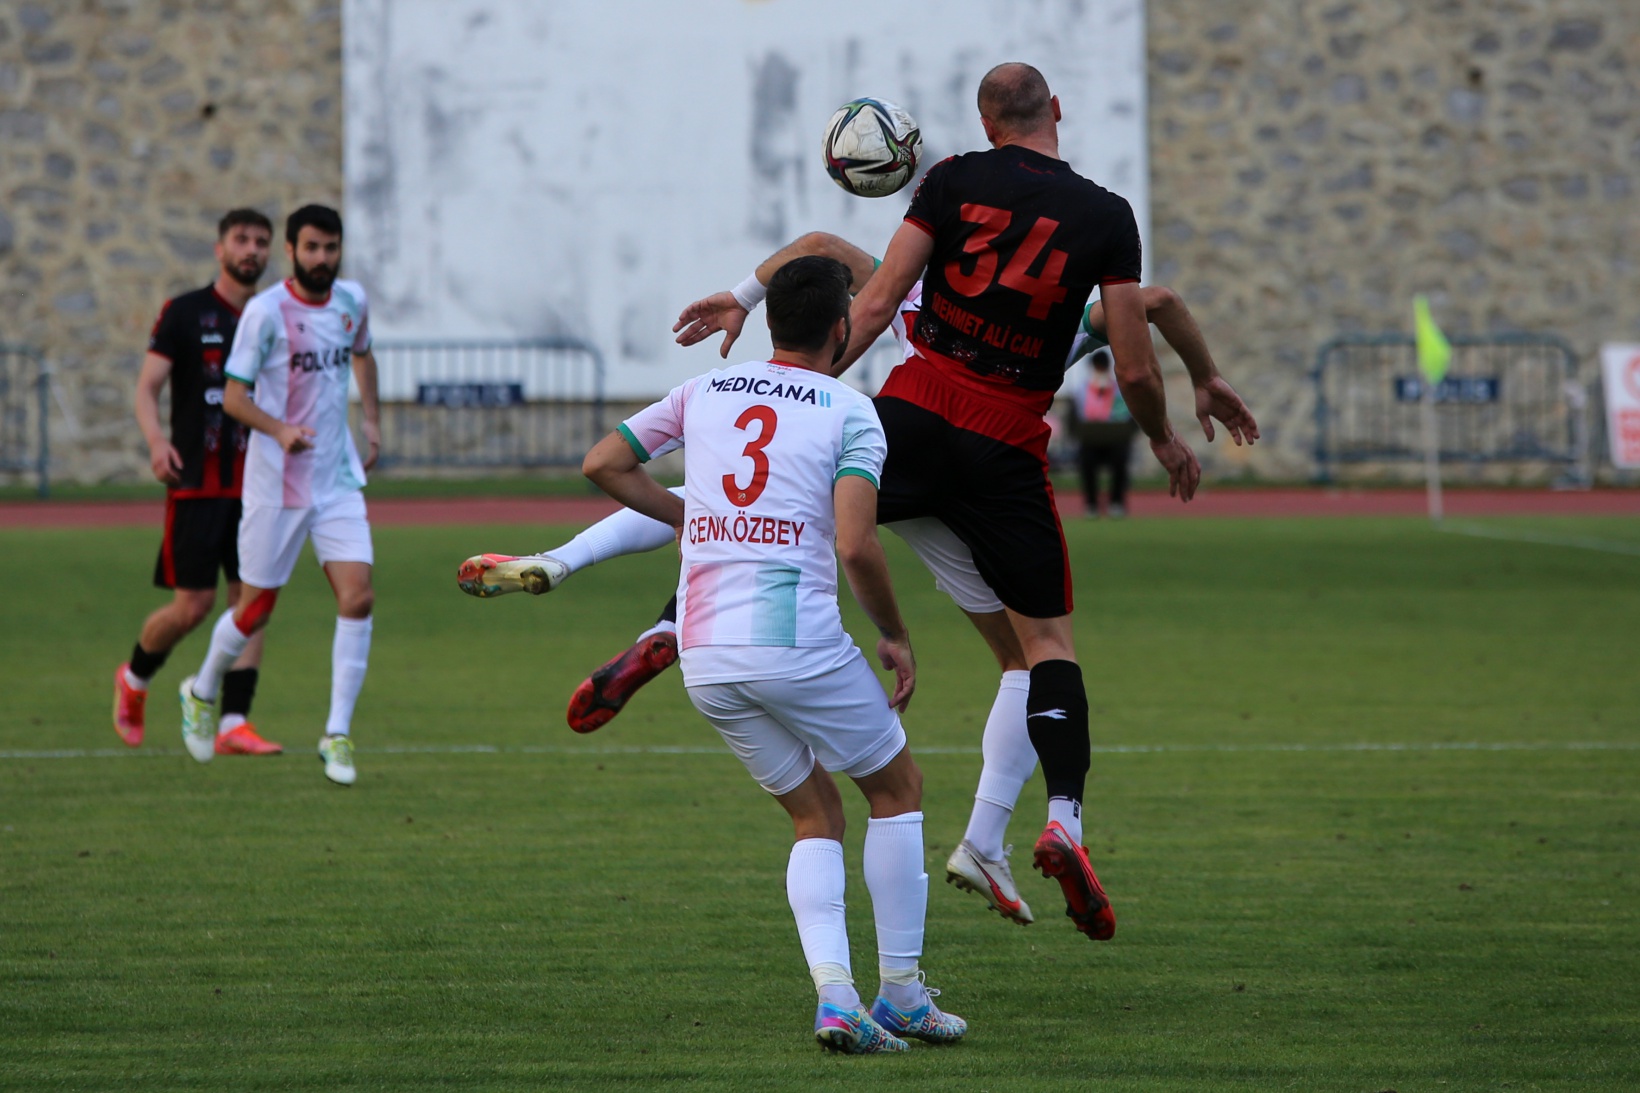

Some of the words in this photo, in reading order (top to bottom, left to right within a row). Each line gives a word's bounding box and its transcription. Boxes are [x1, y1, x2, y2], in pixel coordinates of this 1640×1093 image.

[944, 203, 1069, 320] 34
[931, 292, 984, 338] MEHMET
[982, 325, 1011, 350] ALİ
[1010, 333, 1044, 358] CAN
[706, 377, 816, 405] MEDICANA
[722, 405, 778, 507] 3
[689, 516, 732, 545] CENK
[733, 511, 805, 546] ÖZBEY
